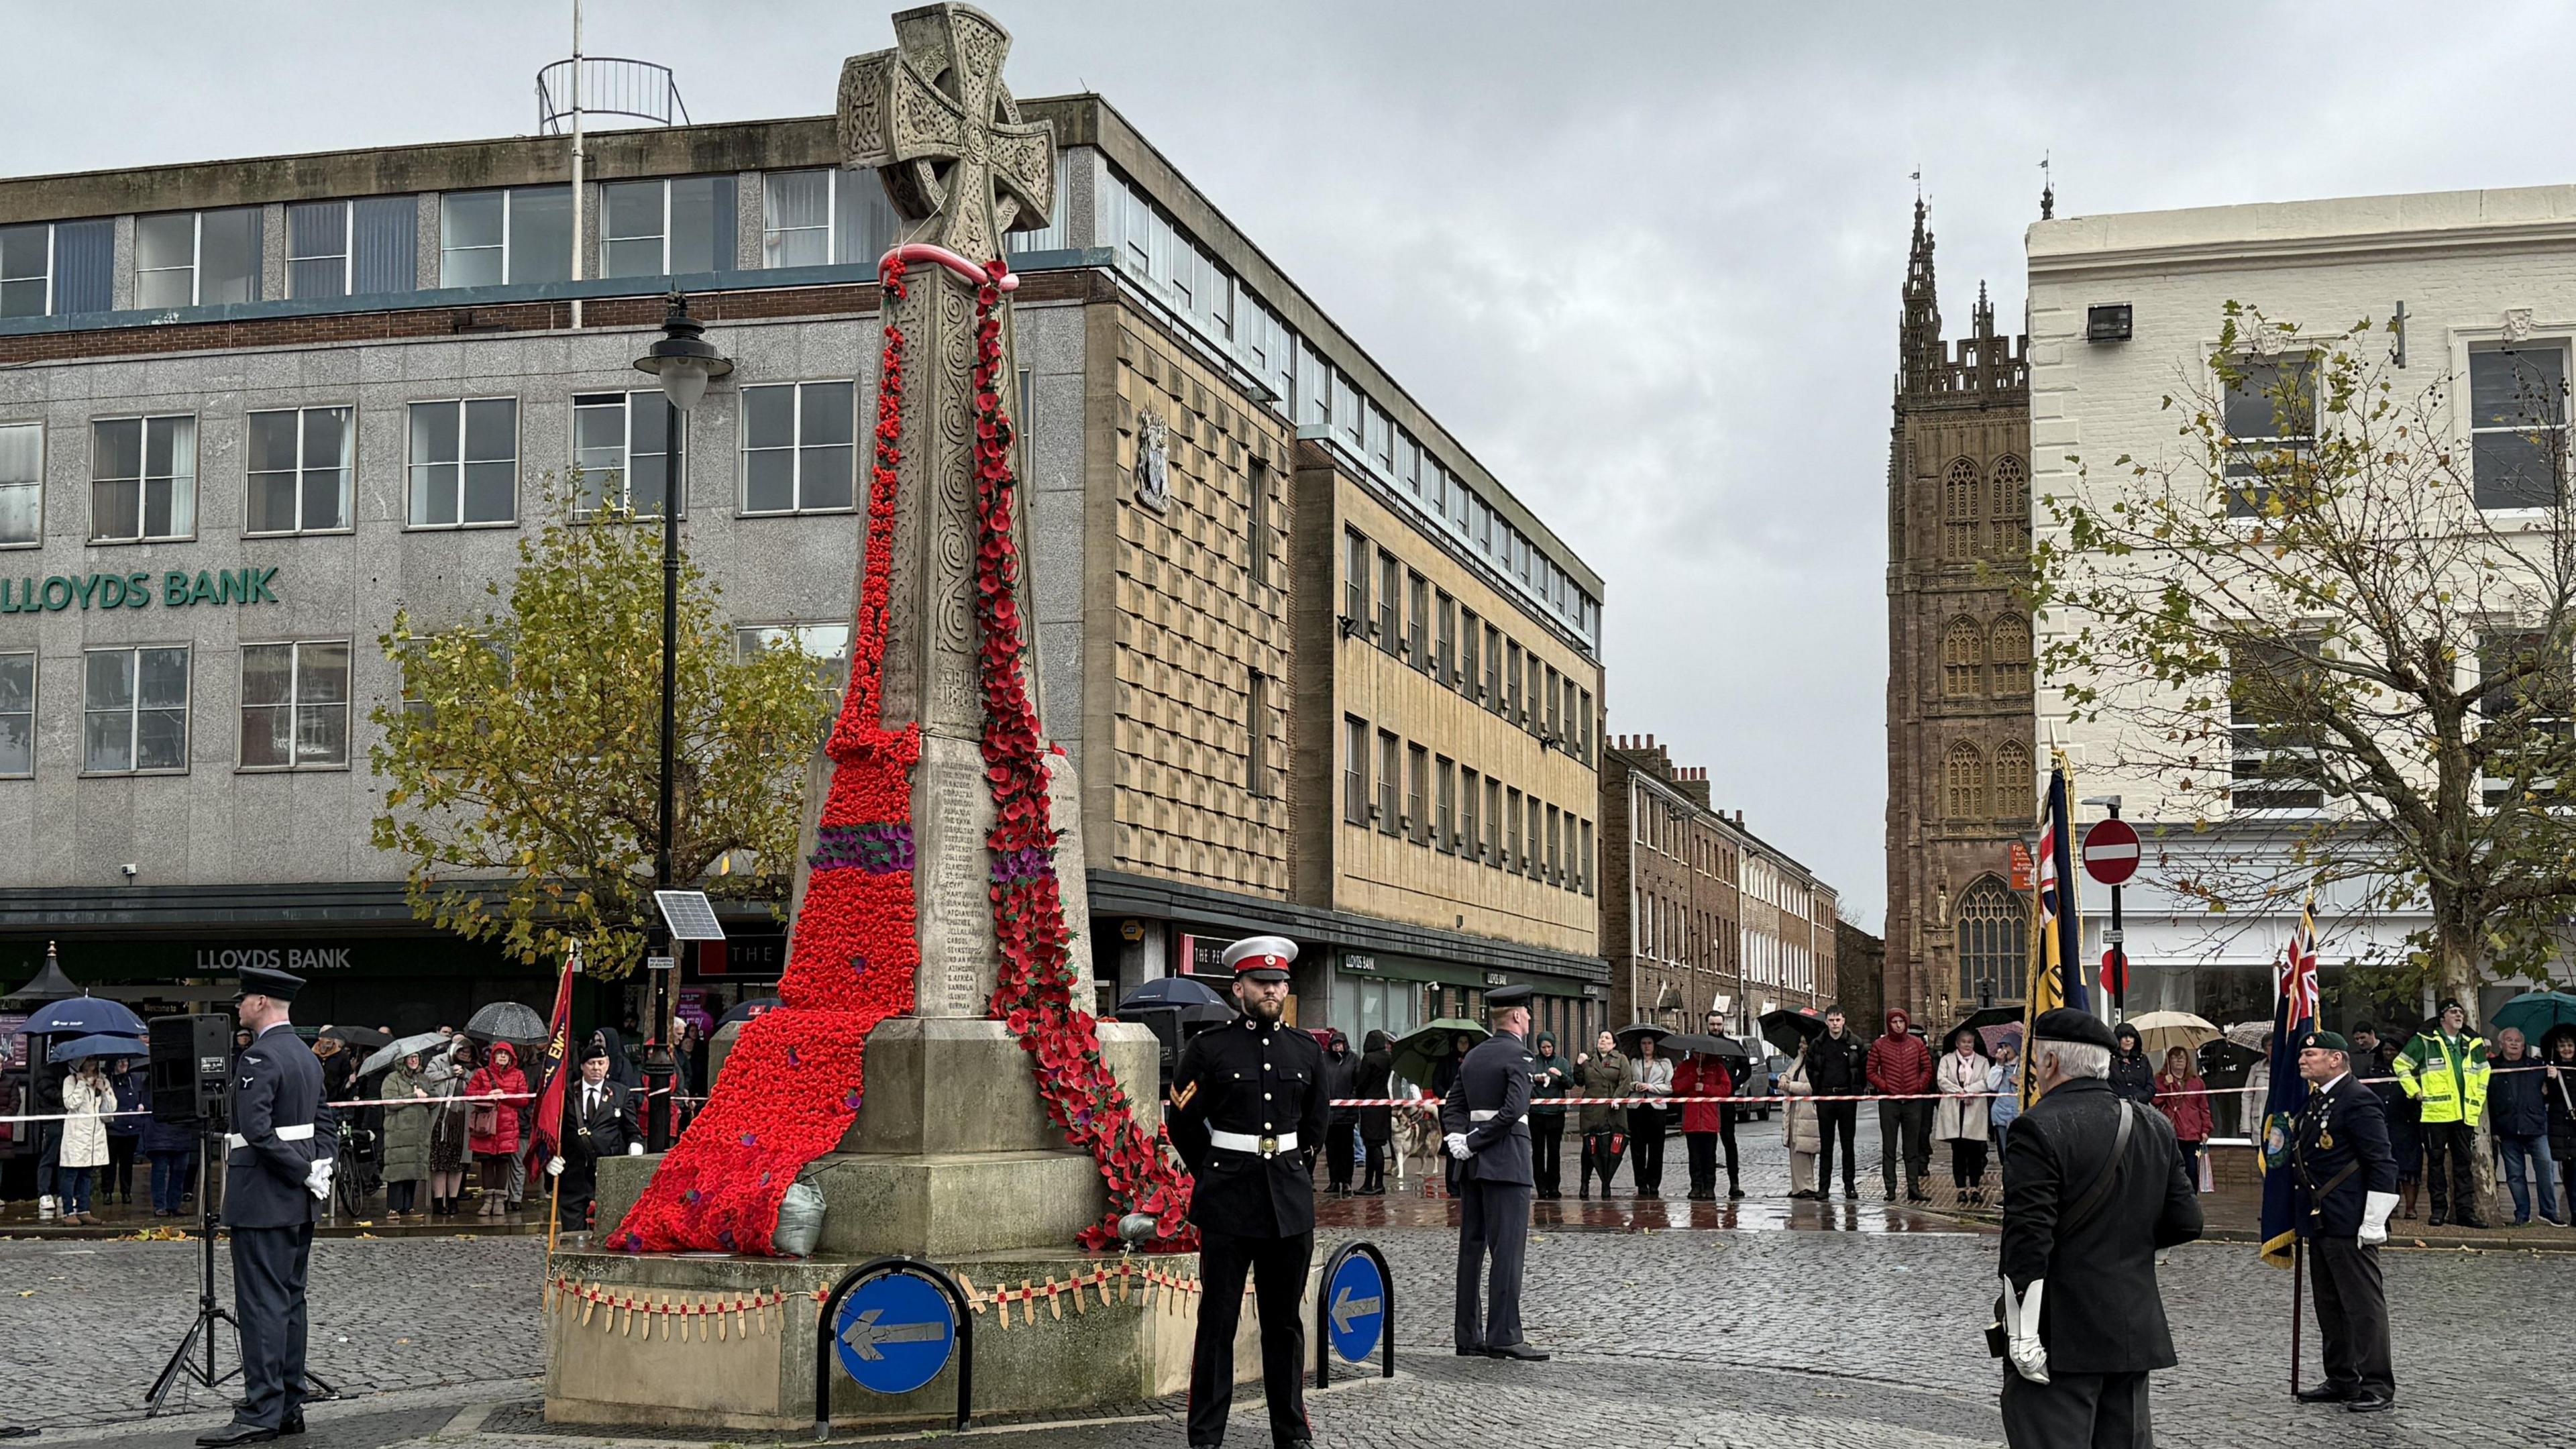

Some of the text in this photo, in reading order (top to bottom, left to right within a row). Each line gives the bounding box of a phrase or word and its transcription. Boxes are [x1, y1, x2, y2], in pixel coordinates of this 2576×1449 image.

[1, 566, 279, 612] LLOYDS BANK
[197, 949, 351, 969] LLOYDS BANK
[733, 947, 771, 961] THE
[1195, 947, 1208, 963] THE
